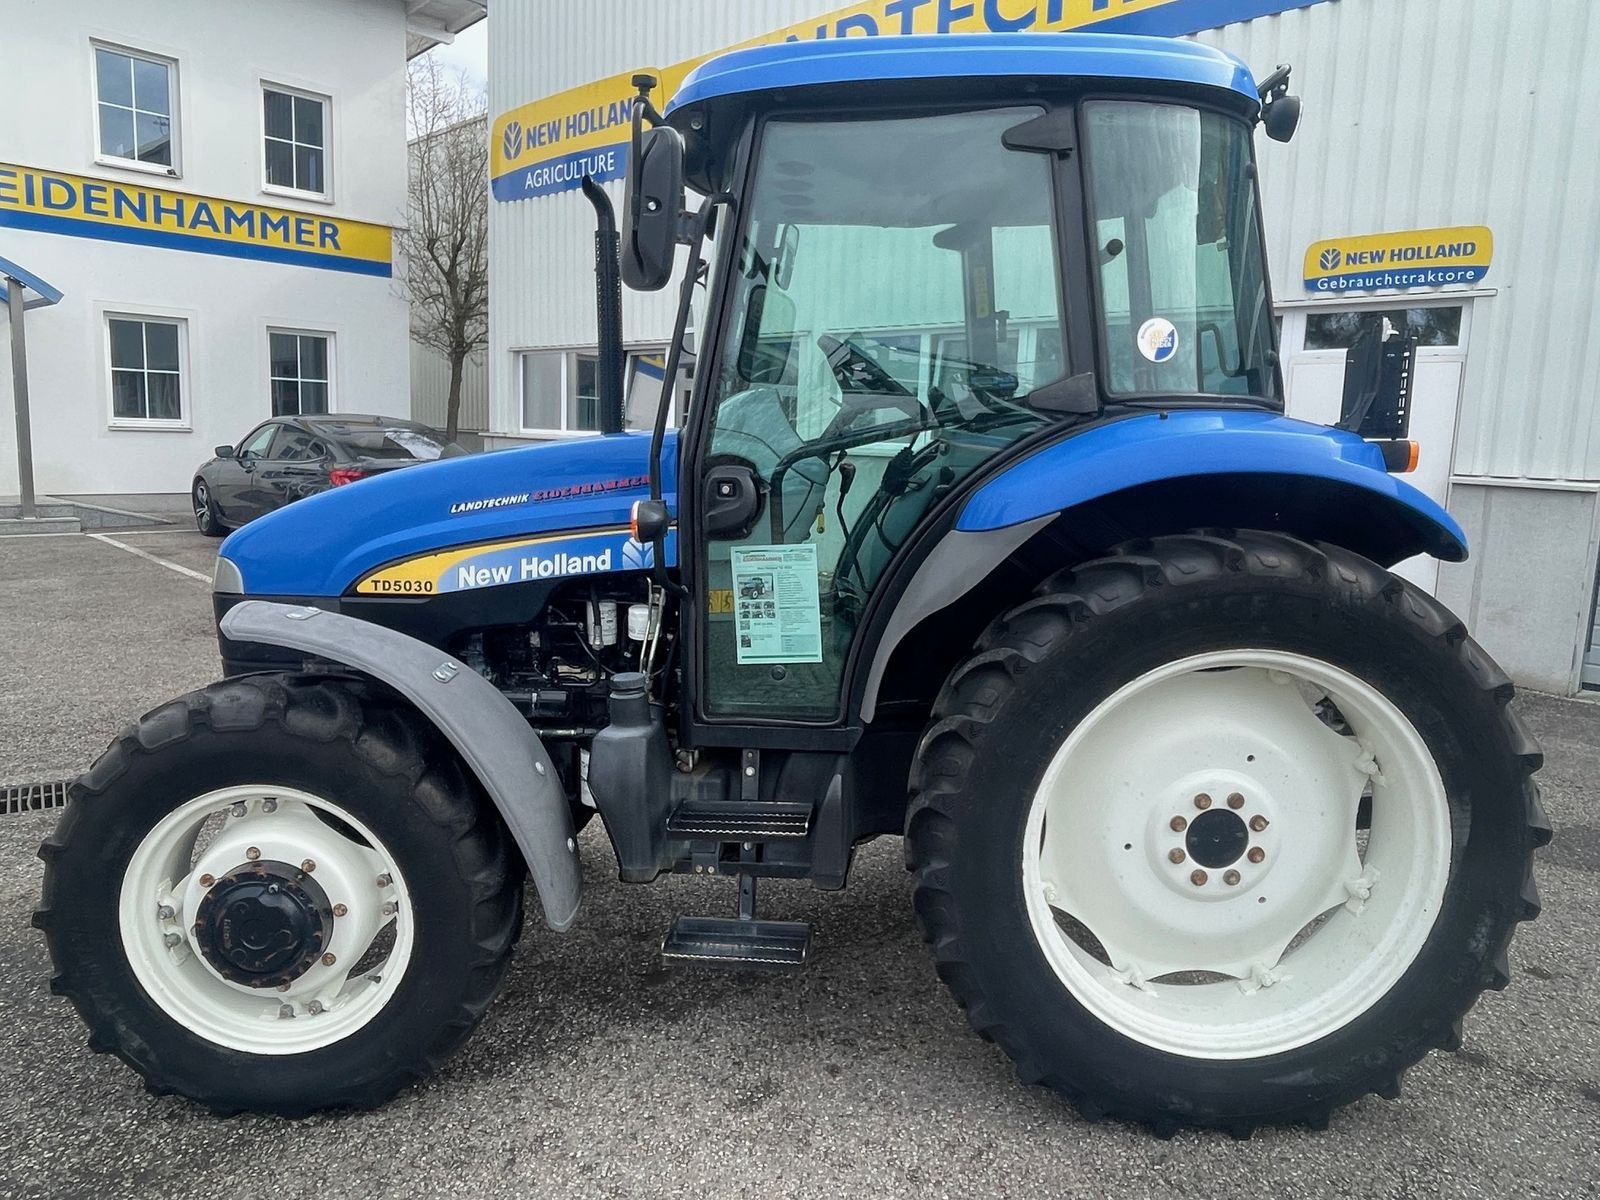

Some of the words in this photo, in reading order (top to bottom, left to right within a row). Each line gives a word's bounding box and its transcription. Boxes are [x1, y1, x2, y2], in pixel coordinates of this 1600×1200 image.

[526, 118, 562, 149] NEW
[567, 97, 633, 138] HOLLAN
[525, 152, 615, 189] AGRICULTURE
[0, 169, 342, 250] EIDENHAMMER
[1345, 249, 1386, 266] NEW
[1390, 242, 1476, 263] HOLLAND
[1317, 270, 1475, 289] Gebrauchttraktore
[450, 492, 531, 514] LANDTECHNIK
[457, 564, 512, 589] New
[520, 549, 612, 580] Holland
[370, 579, 434, 594] TD5030
